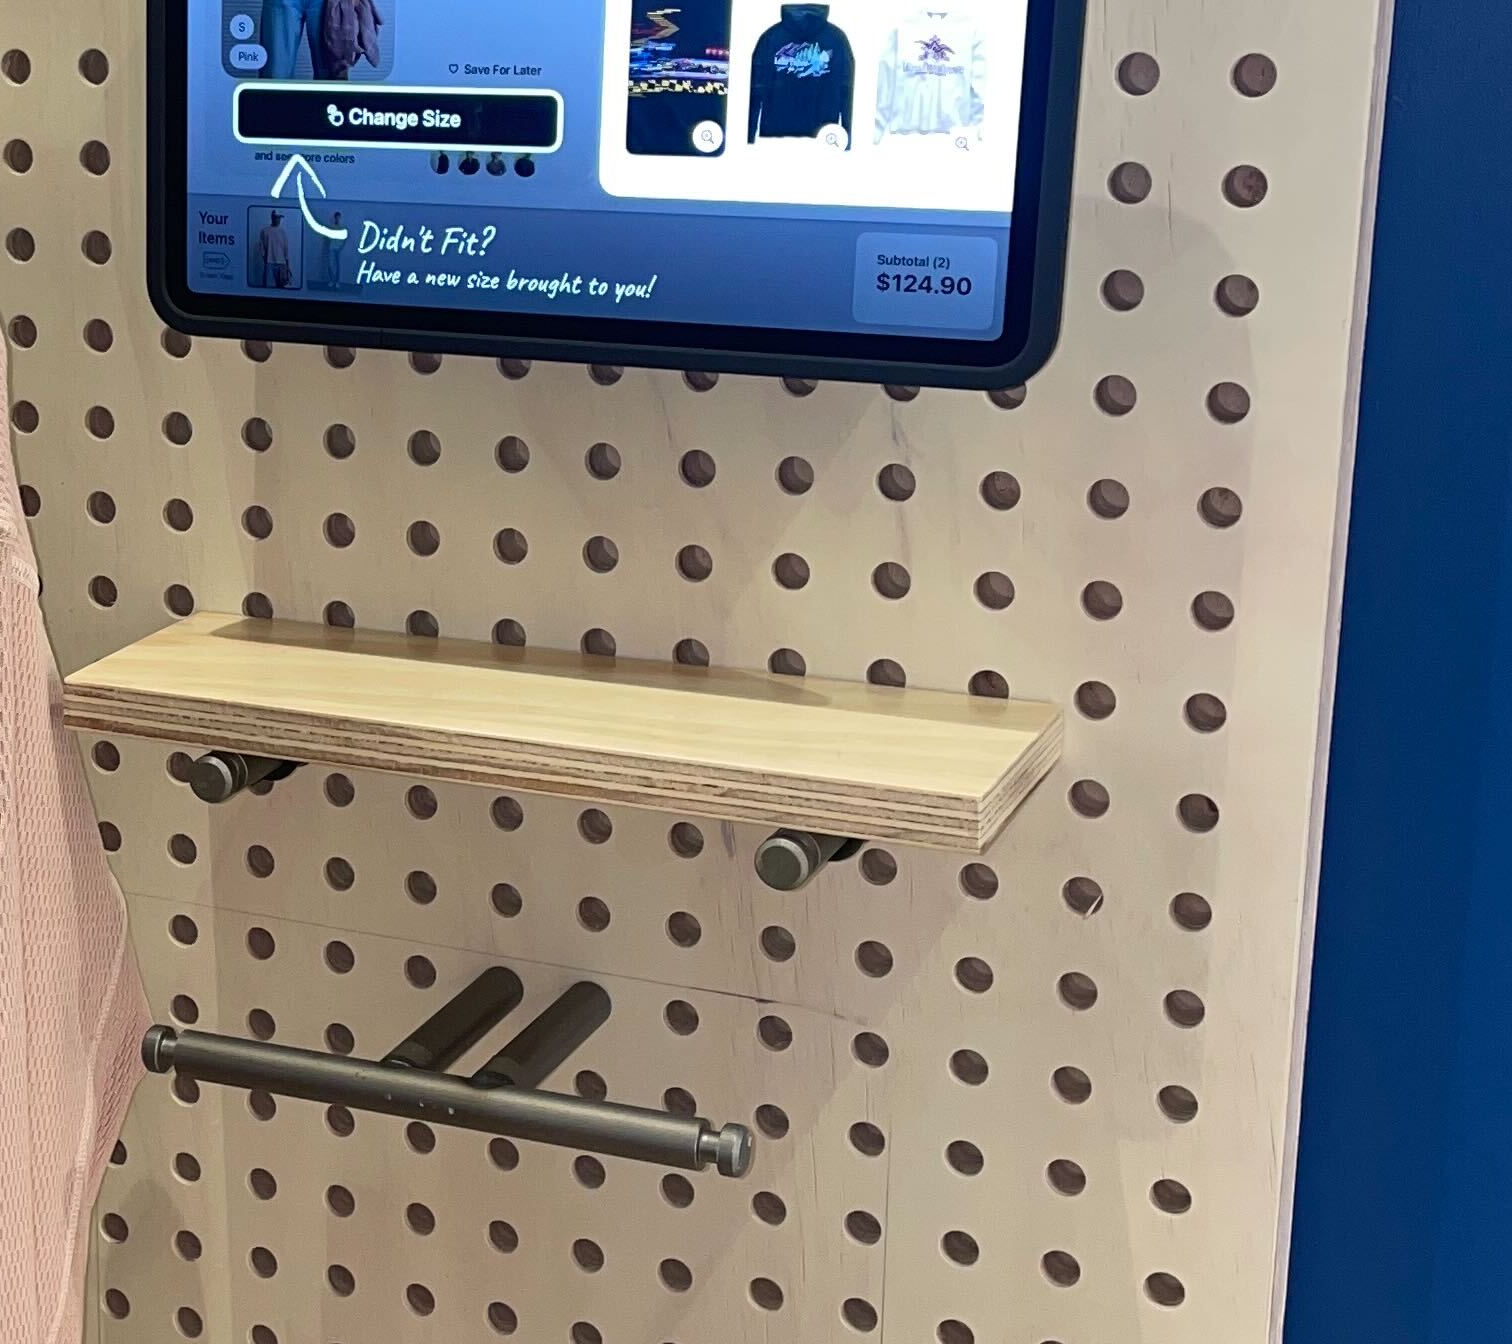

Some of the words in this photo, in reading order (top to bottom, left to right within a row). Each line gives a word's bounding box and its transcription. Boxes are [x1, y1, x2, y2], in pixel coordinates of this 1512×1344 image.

[238, 21, 246, 33] S
[238, 51, 259, 62] Pink
[464, 63, 490, 75] Save
[492, 64, 511, 75] For
[513, 65, 542, 76] Later
[349, 107, 419, 130] Change
[422, 109, 462, 128] Size
[254, 150, 273, 161] and
[324, 152, 356, 164] colors
[198, 210, 229, 225] Your
[198, 230, 235, 245] Items
[358, 220, 434, 254] Didn't
[441, 225, 497, 256] Fit?
[876, 254, 930, 268] Subtotal
[932, 256, 951, 270] (2)
[356, 260, 402, 285] Have
[407, 272, 420, 285] a
[425, 272, 461, 287] new
[467, 270, 500, 289] size
[506, 269, 583, 299] brought
[589, 277, 609, 296] to
[615, 274, 658, 304] you!
[876, 271, 972, 296] $124.90
